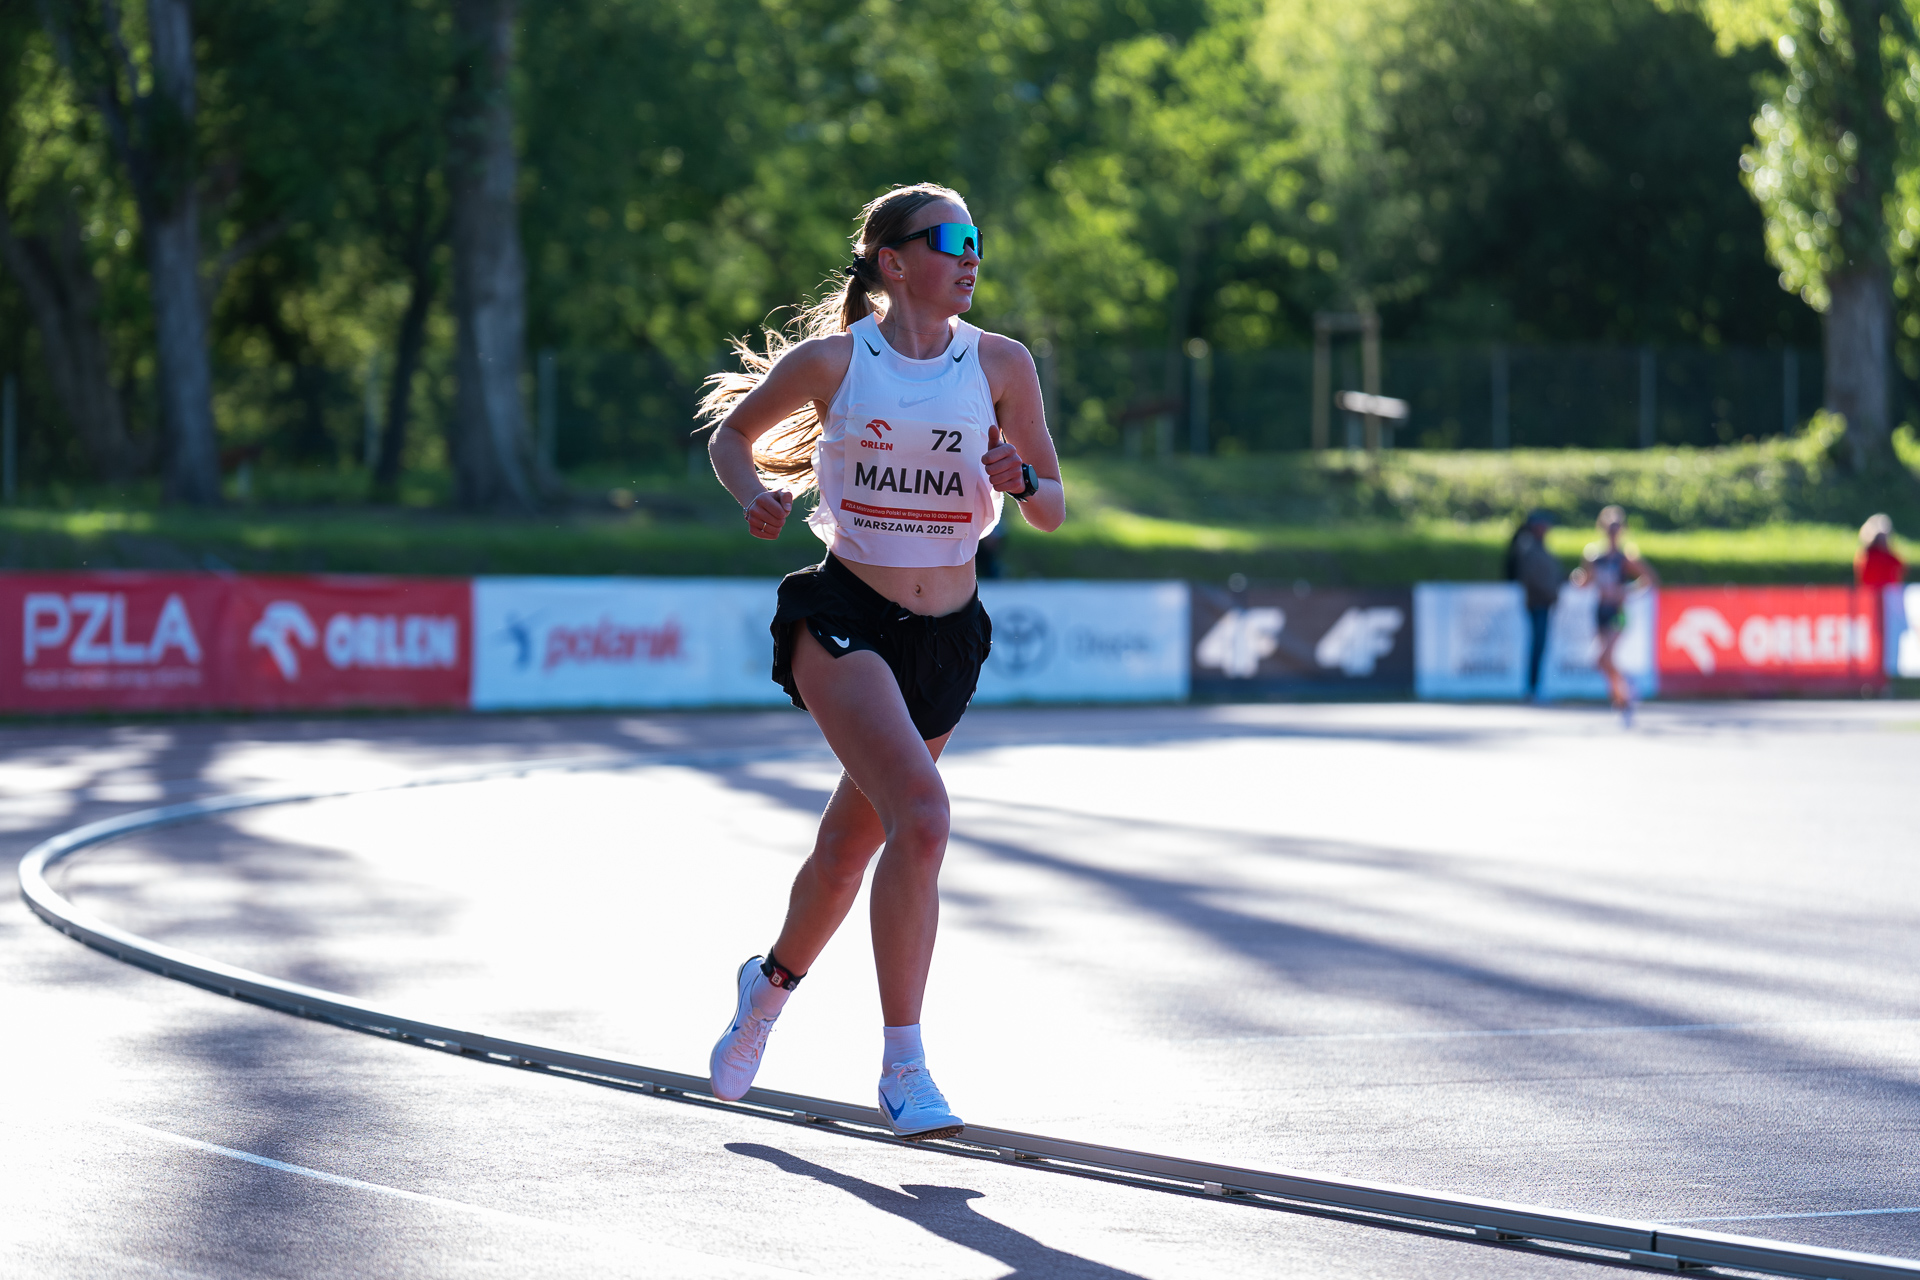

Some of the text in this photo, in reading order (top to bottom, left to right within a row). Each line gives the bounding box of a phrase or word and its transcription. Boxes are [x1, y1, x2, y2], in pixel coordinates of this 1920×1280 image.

[860, 439, 893, 451] ORLEN
[931, 429, 962, 453] 72
[854, 462, 964, 497] MALINA
[853, 516, 954, 535] WARSZAWA 2025
[907, 511, 922, 519] Biegu
[23, 592, 200, 664] PZLA
[324, 613, 459, 668] ORLEN
[1196, 606, 1286, 678] 4F
[1314, 606, 1404, 678] 4F
[1738, 613, 1870, 665] ORLEN
